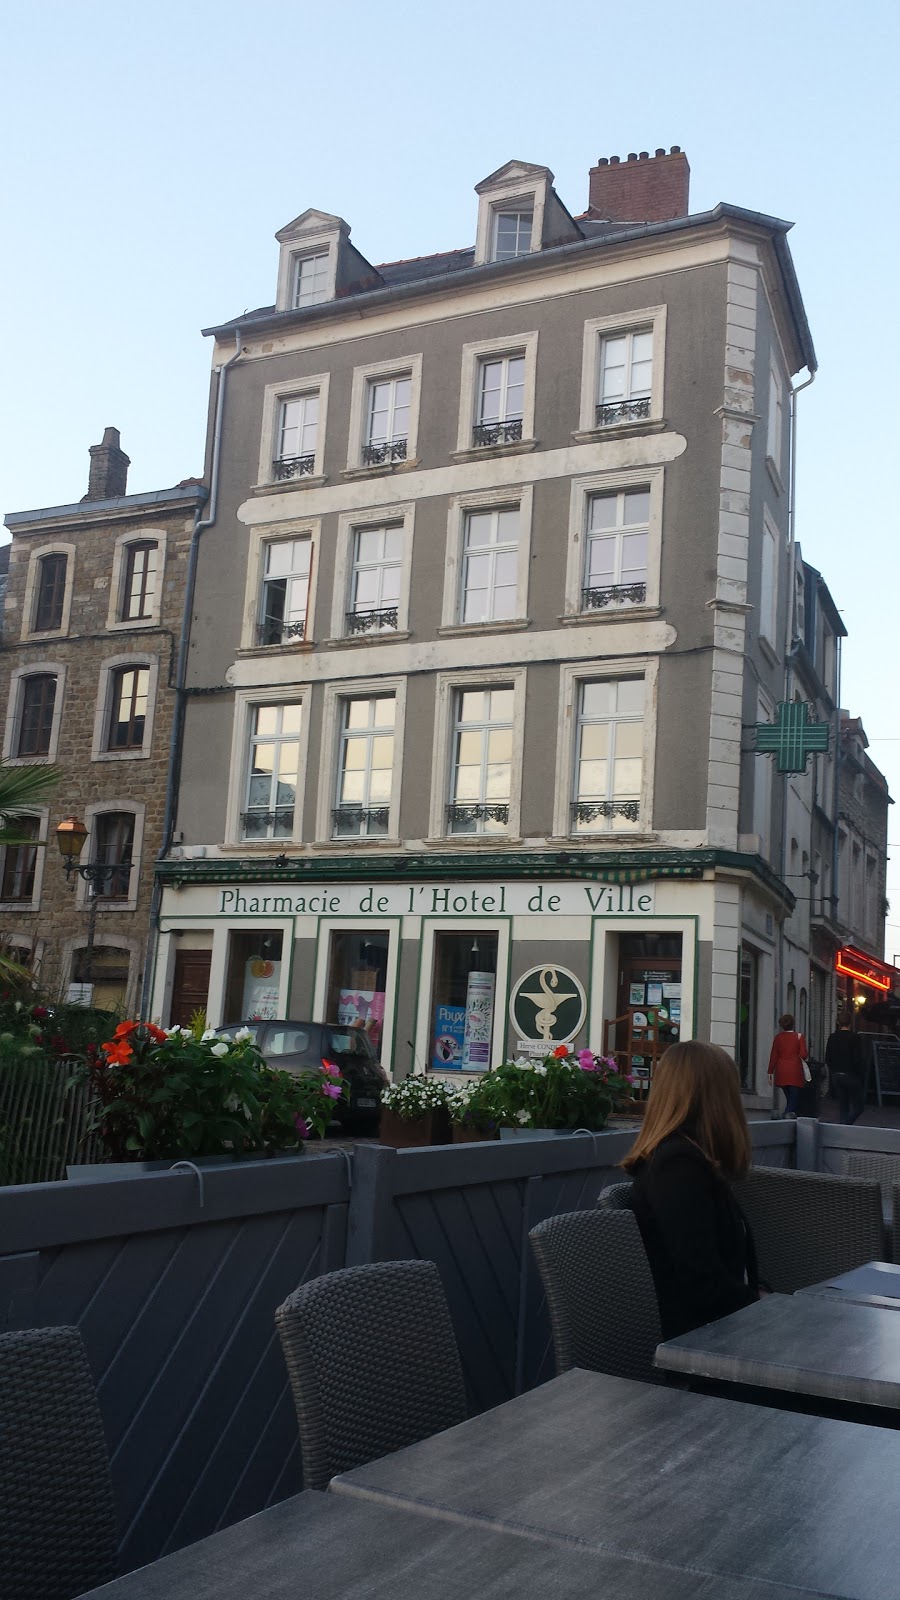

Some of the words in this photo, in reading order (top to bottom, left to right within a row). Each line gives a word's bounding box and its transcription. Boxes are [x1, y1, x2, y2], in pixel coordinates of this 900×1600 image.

[219, 888, 341, 913] Pharmacie
[359, 887, 389, 913] de
[408, 886, 506, 913] l'Hotel
[527, 885, 561, 912] de
[583, 884, 653, 912] Ville
